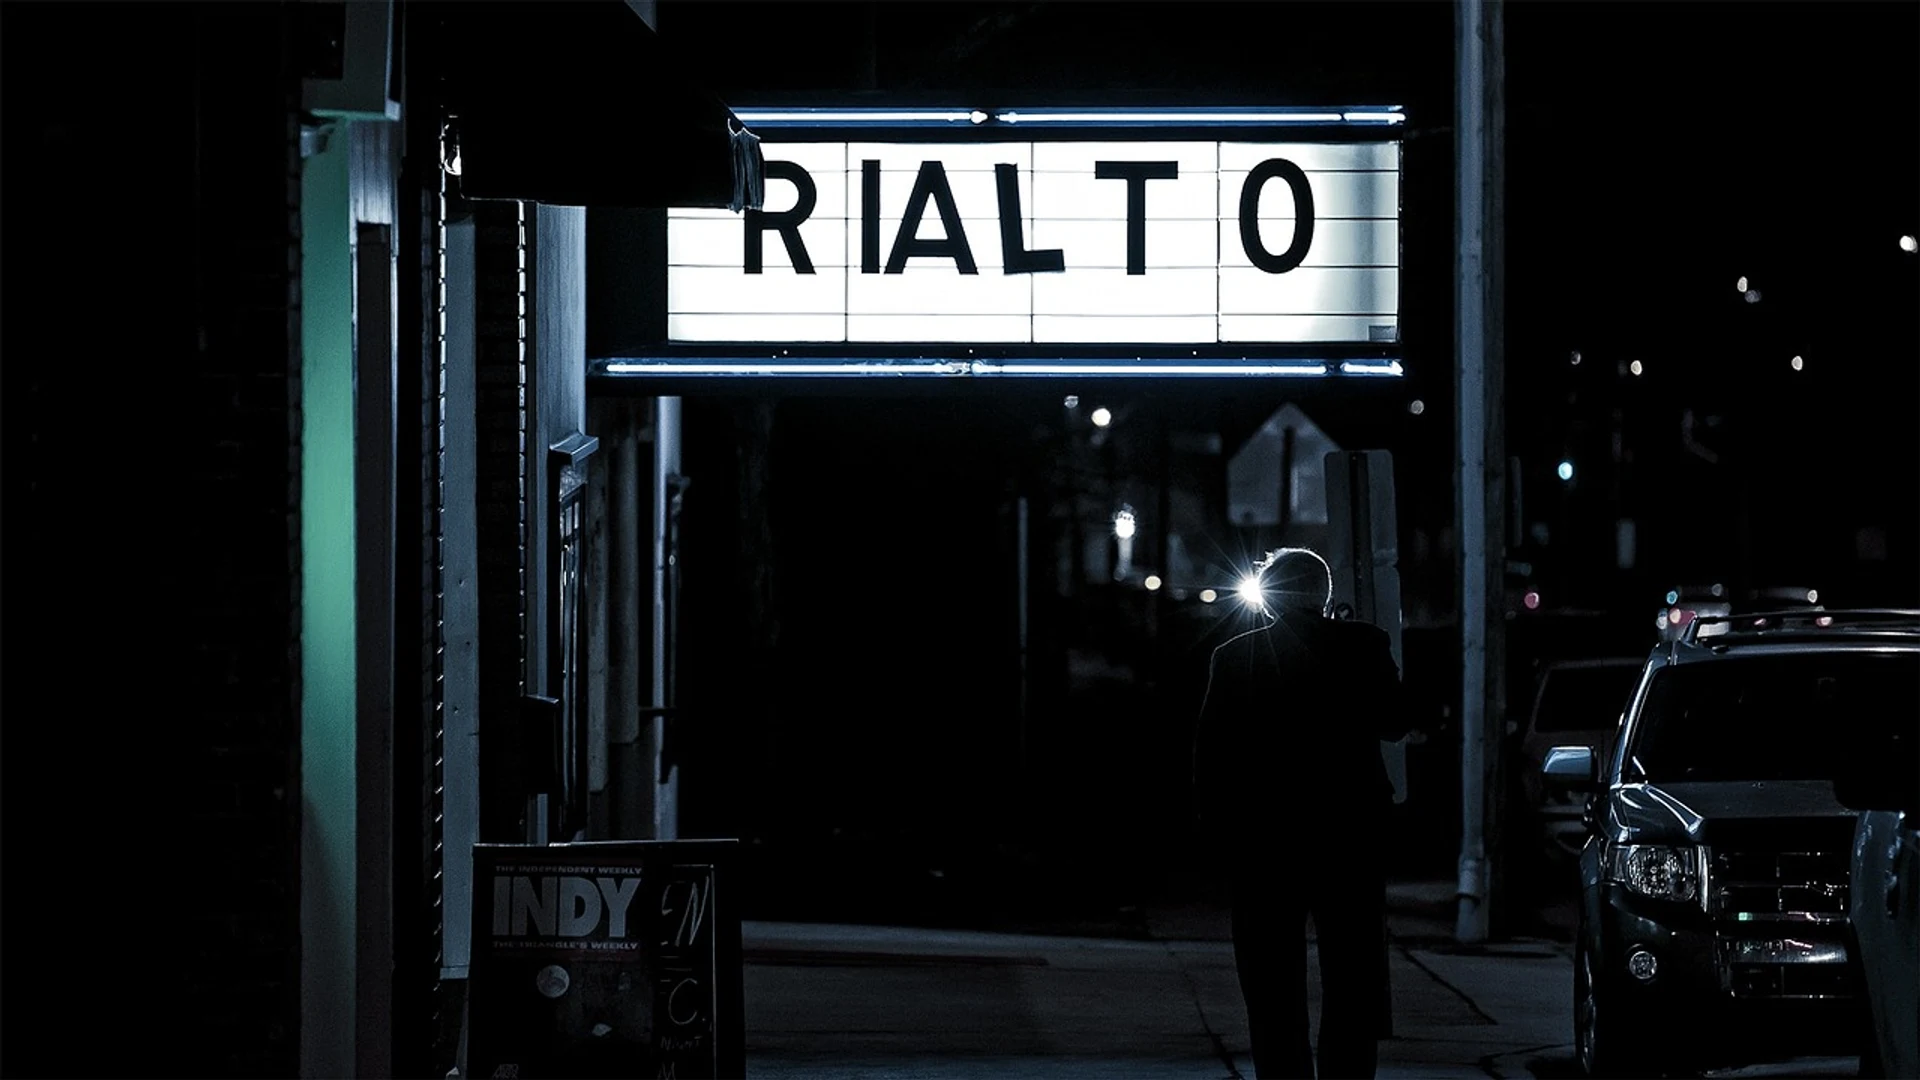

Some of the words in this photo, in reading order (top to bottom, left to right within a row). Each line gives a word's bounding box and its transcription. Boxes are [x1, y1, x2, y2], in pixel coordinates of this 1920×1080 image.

[744, 158, 1315, 276] RIALTO
[495, 865, 515, 873] THE
[517, 865, 596, 874] INDEPENDENT
[598, 866, 642, 875] WEEKLY
[492, 875, 642, 938] INDY
[492, 940, 514, 948] THE
[518, 940, 588, 949] TRIANGLE'S
[591, 941, 638, 950] WEEKLY
